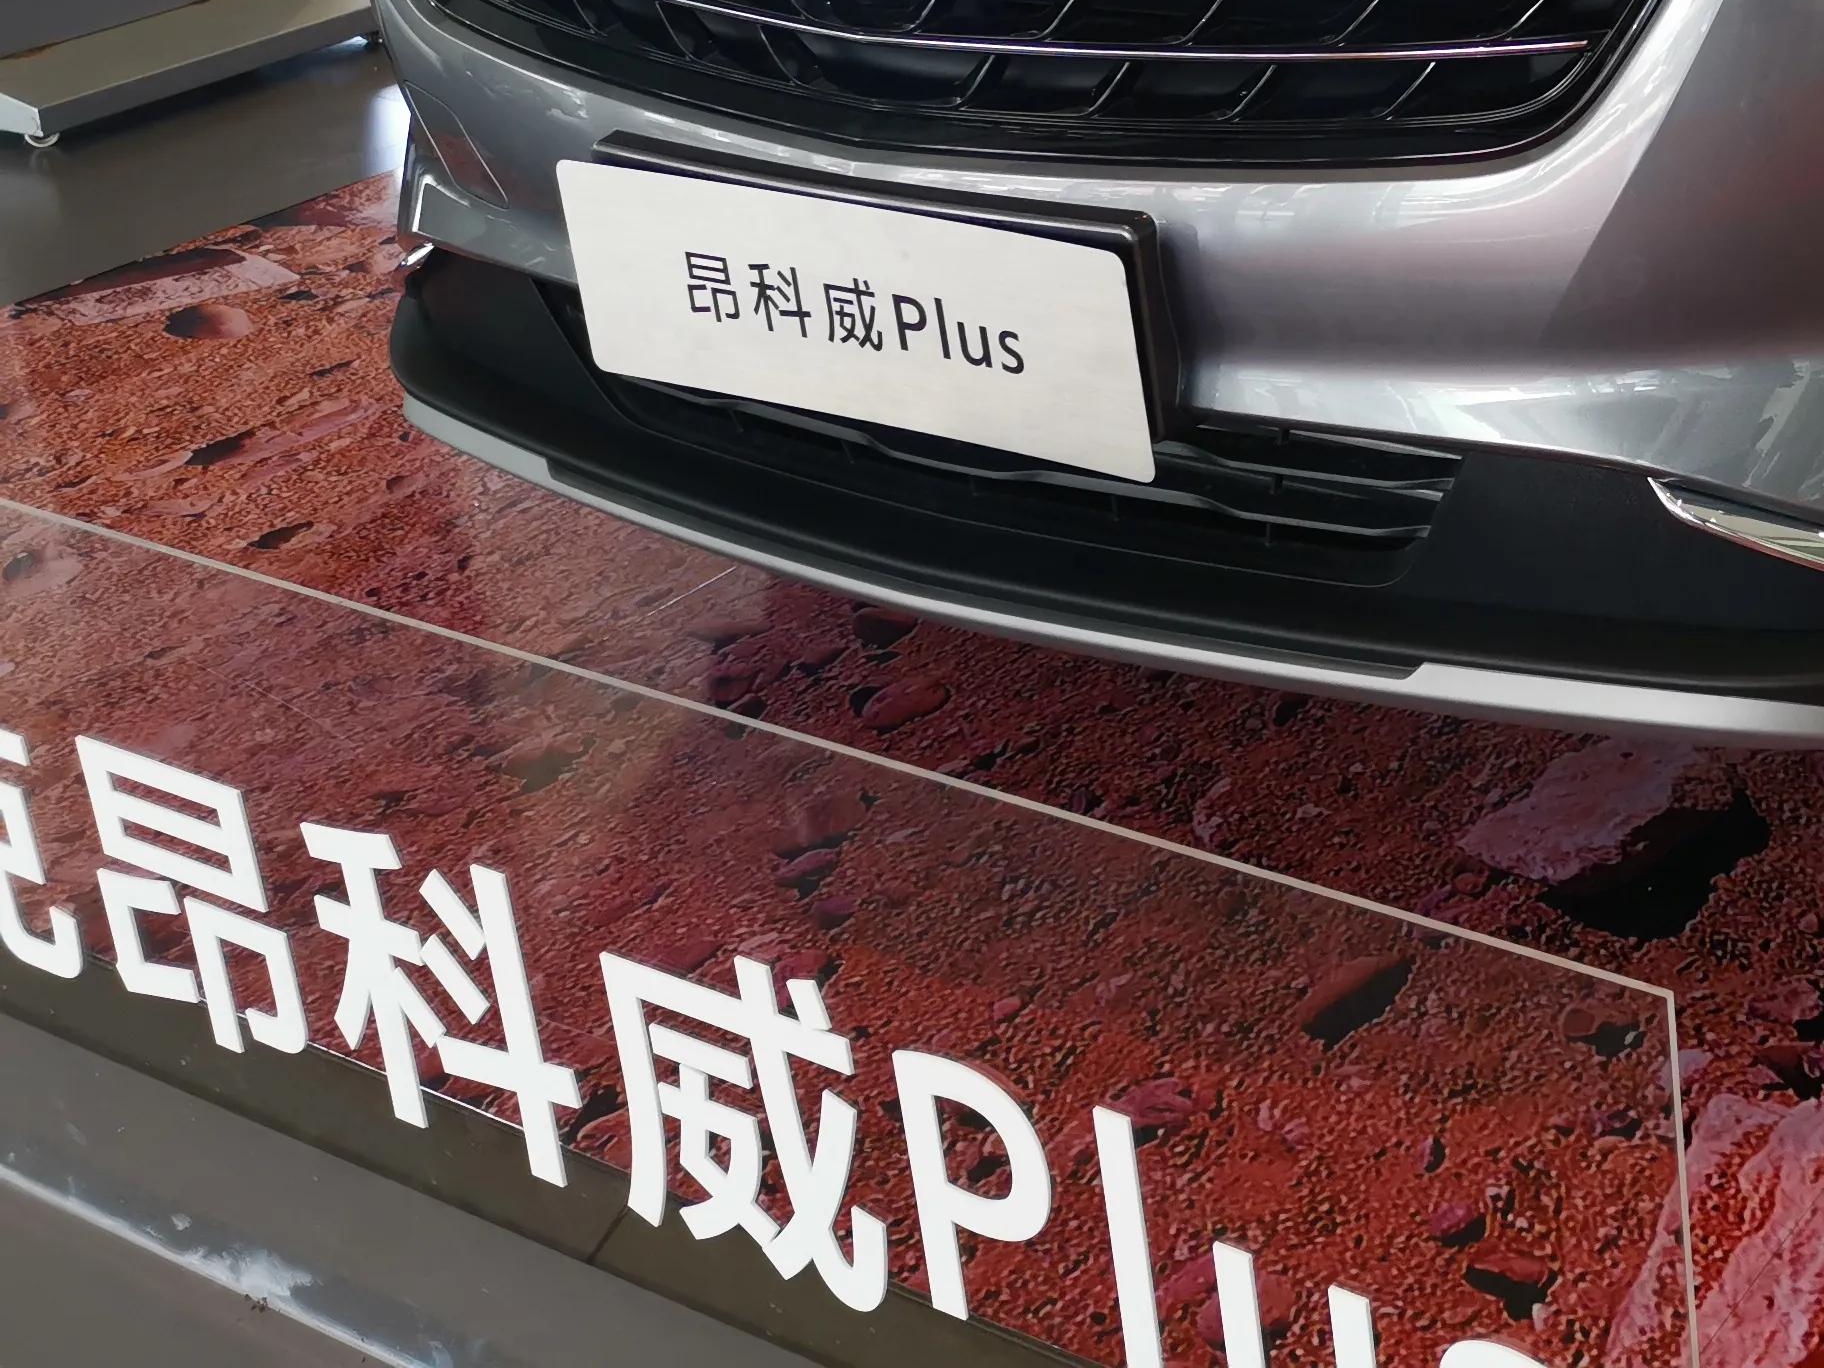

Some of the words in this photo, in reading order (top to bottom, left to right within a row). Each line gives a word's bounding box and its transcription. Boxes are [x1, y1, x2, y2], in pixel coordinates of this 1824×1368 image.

[684, 250, 1026, 376] 昂科威Plus
[0, 730, 1553, 1368] 昂科威Plu
